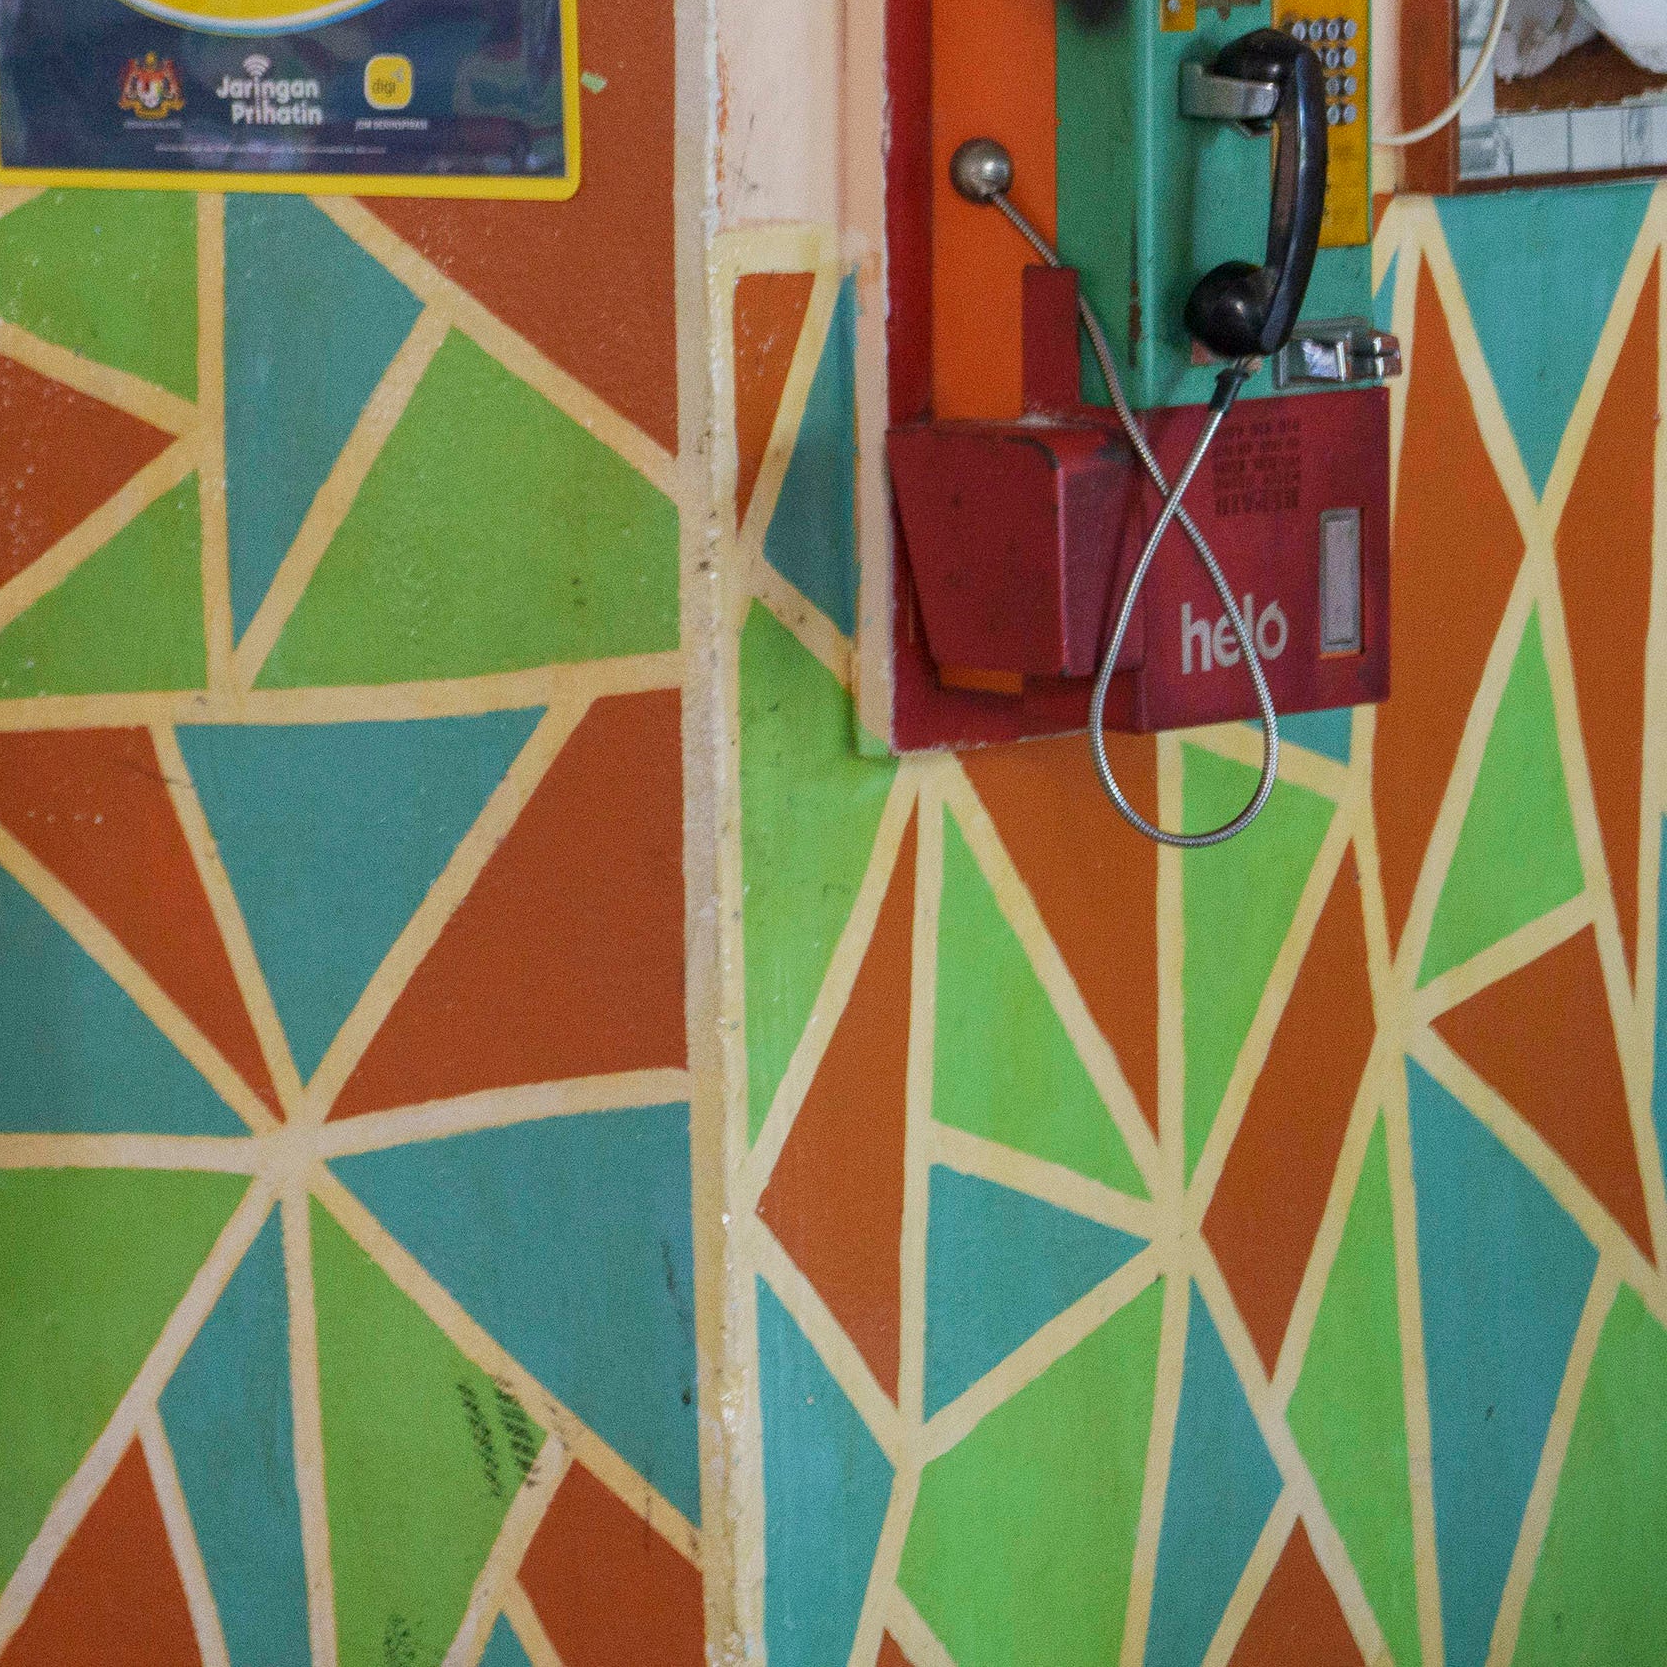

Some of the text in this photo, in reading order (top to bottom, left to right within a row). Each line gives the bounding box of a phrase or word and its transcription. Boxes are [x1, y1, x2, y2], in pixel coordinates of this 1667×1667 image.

[217, 76, 318, 104] Jaringan
[231, 102, 324, 126] Prihatin
[1181, 593, 1288, 675] helo
